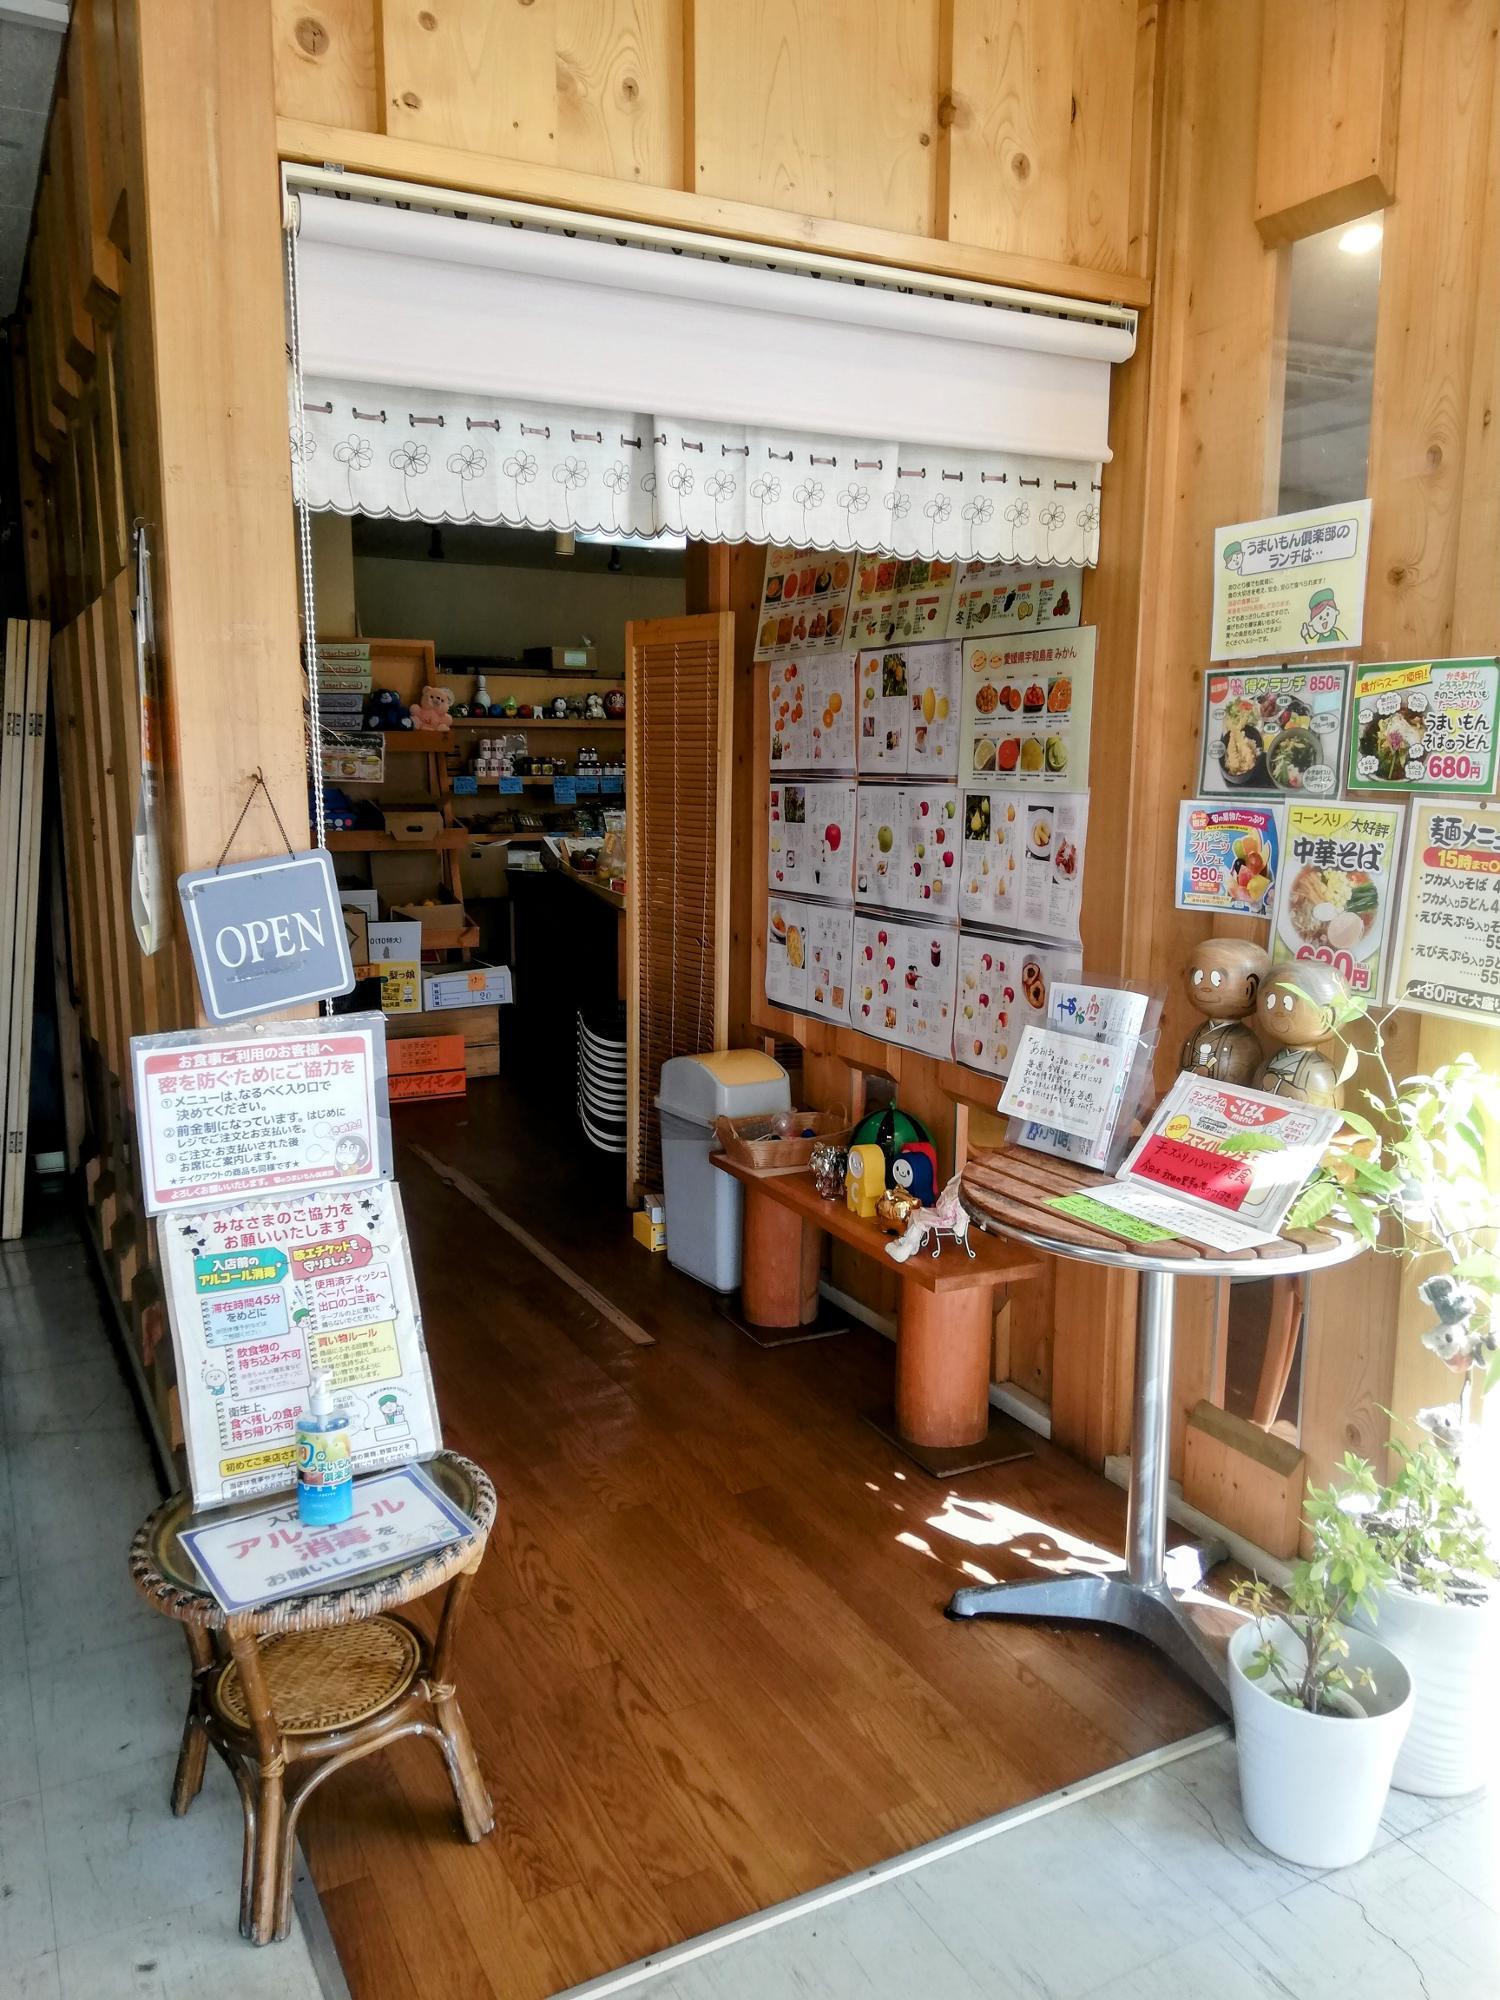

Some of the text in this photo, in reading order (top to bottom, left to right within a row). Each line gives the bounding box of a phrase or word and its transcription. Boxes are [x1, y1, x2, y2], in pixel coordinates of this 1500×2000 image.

[1247, 524, 1351, 556] うまいもん倶楽部の
[1426, 713, 1490, 731] うまいもん
[1428, 755, 1481, 779] 680円
[1293, 812, 1390, 838] コーン入り 大好評
[1189, 841, 1231, 855] フルーツ
[1293, 837, 1385, 872] 中華そば
[1191, 866, 1224, 883] 580円
[214, 907, 326, 970] OPEN
[179, 1042, 335, 1070] お食事ご利用のお客様へ
[157, 1060, 356, 1096] 密を防ぐためにご協力を
[176, 1103, 268, 1122] 決めてください。
[1229, 1098, 1267, 1123] ごはん
[1231, 1112, 1256, 1126] menu
[177, 1125, 307, 1150] レジでご注文とお支払いを。
[180, 1152, 277, 1174] お席にご案内します。
[213, 1202, 353, 1234] みなさまのご協力を
[223, 1219, 349, 1250] お願いいたします
[213, 1256, 259, 1272] 入店前の
[303, 1255, 354, 1275] 守りましょう
[211, 1293, 281, 1315] 滞在時間45分
[318, 1293, 385, 1313] 出口のゴミ箱へ
[226, 1308, 267, 1325] をめどに
[317, 1327, 378, 1348] 買い物ルール
[237, 1341, 280, 1360] 飲食物の
[238, 1348, 301, 1372] 持ち込み不可
[228, 1402, 267, 1418] 衛生上、
[230, 1405, 304, 1431] 食べ残しの食品
[231, 1419, 294, 1443] 持ち帰り不可
[265, 1540, 394, 1588] お願いします
